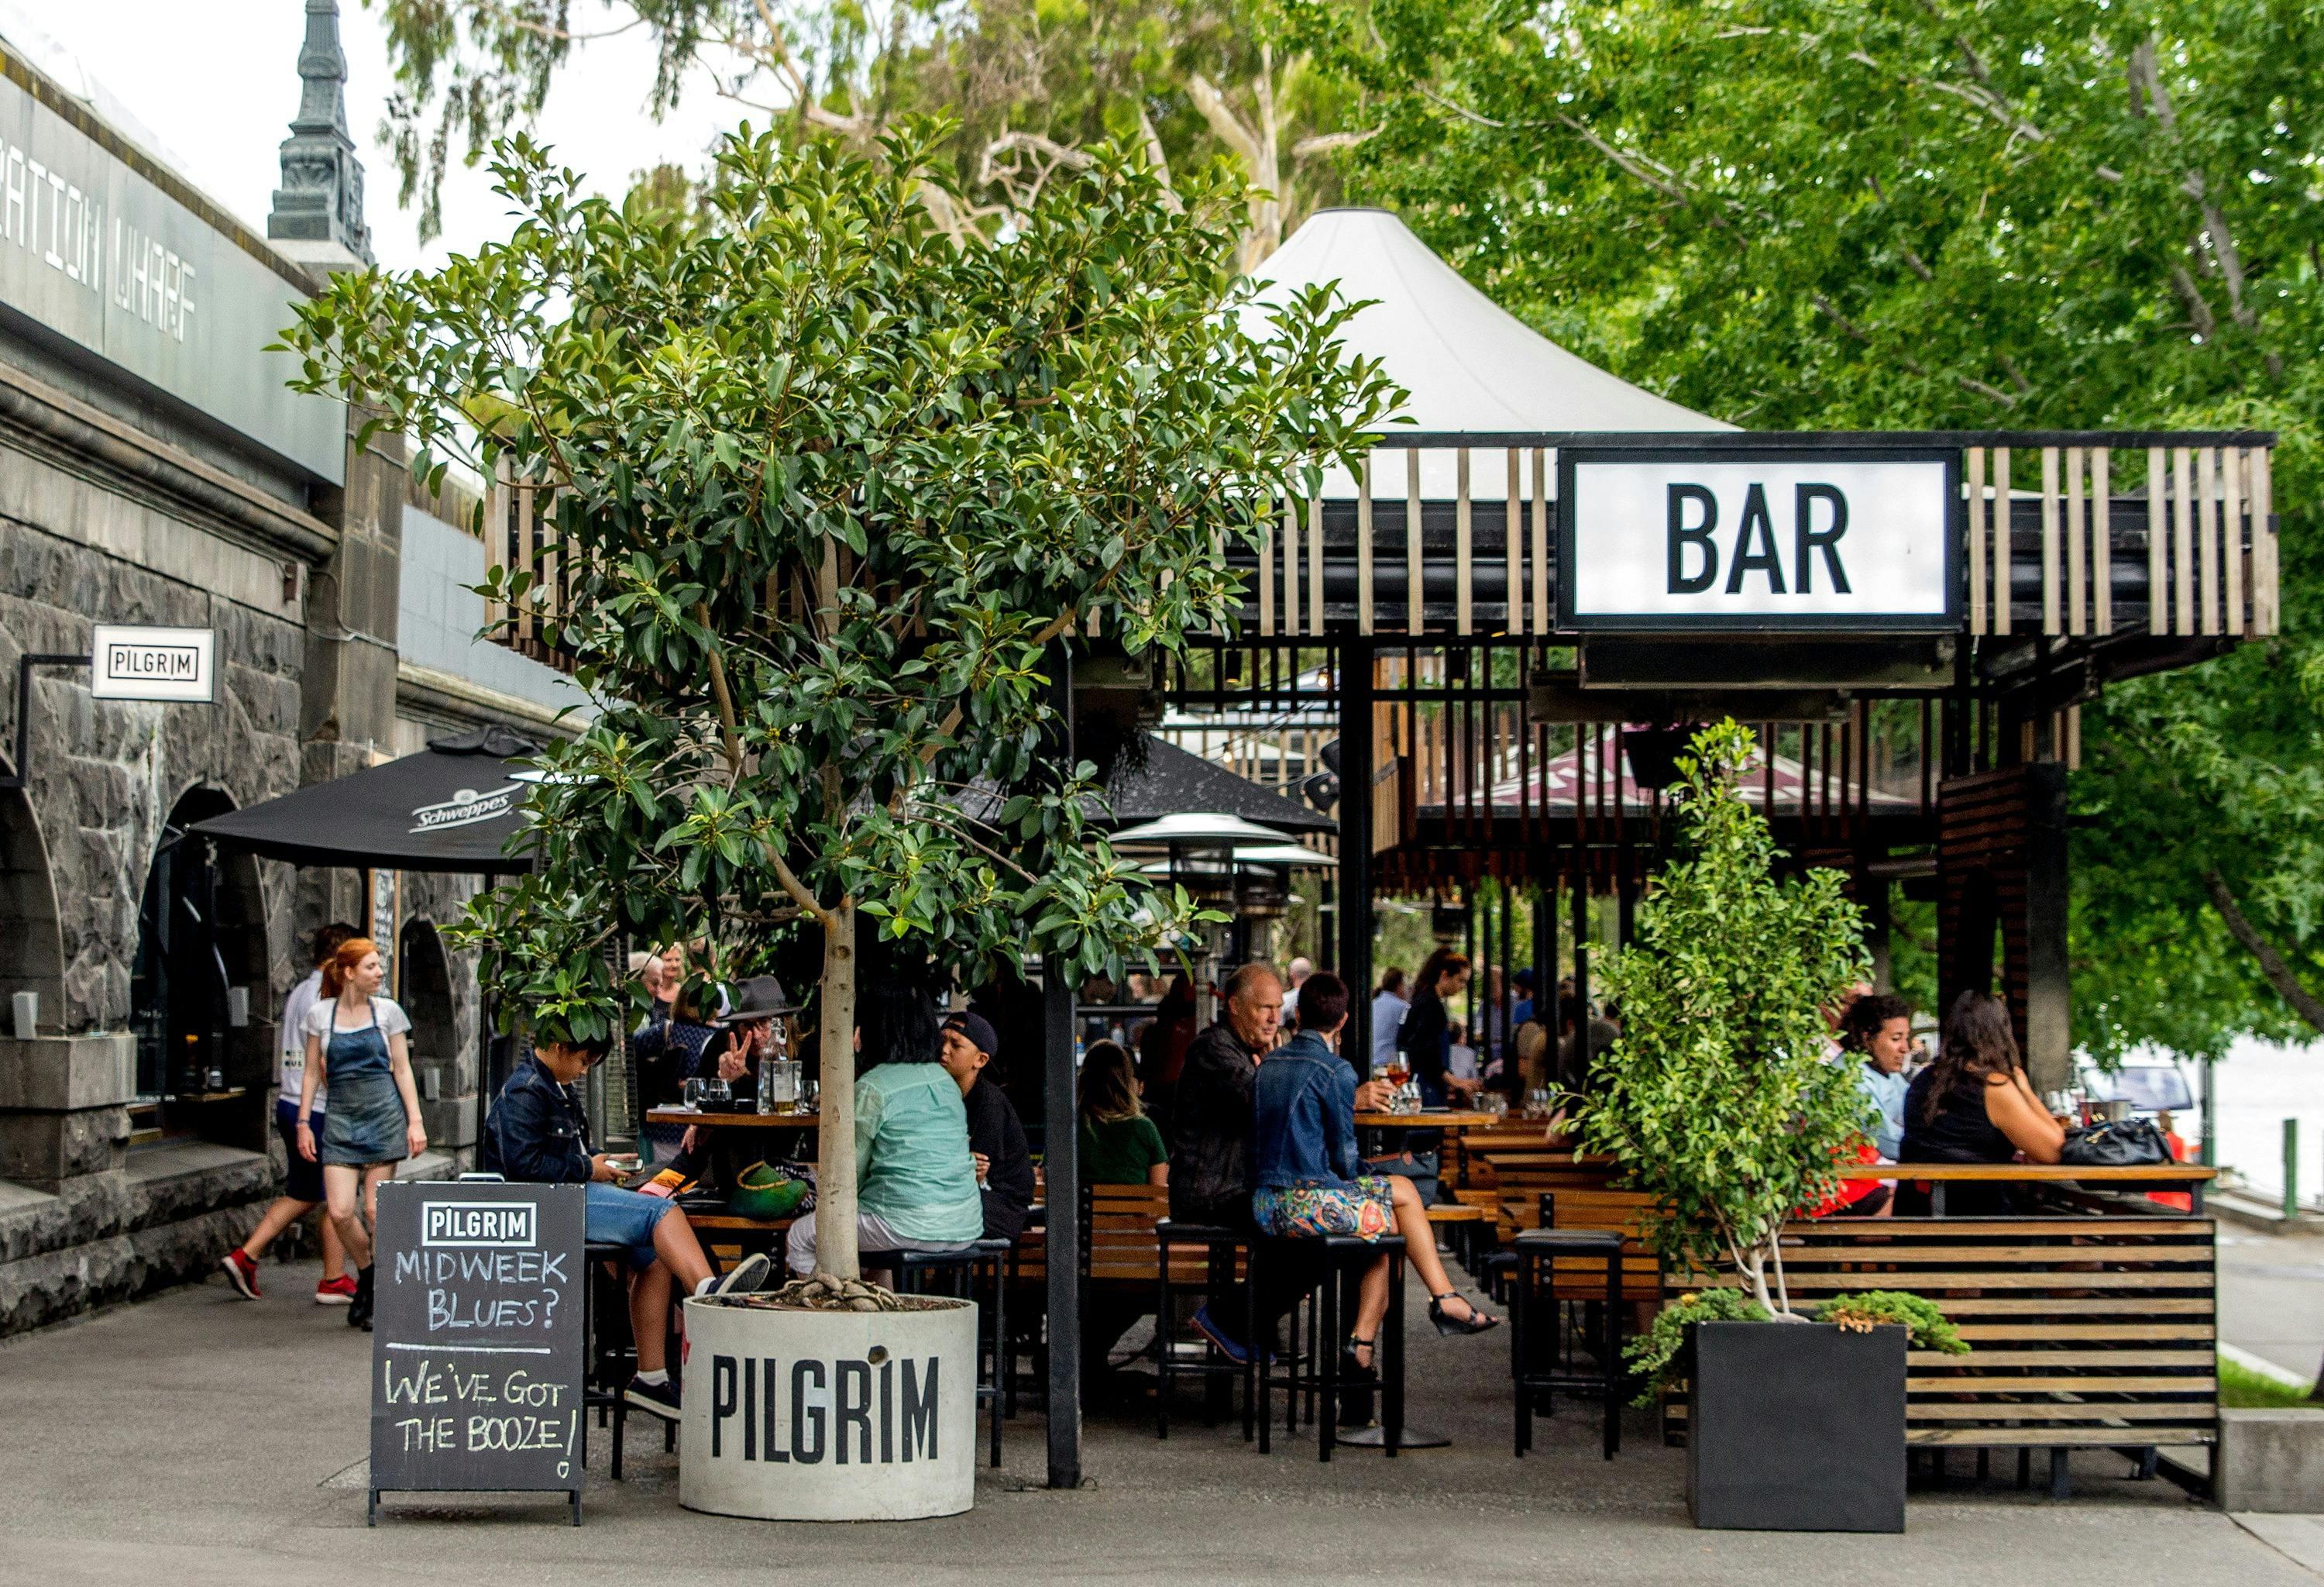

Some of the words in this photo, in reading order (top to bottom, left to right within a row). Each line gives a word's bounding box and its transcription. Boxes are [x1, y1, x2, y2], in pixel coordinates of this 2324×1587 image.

[0, 136, 101, 294] ATION
[114, 216, 195, 343] WHARF
[1666, 482, 1851, 594] BAR
[115, 650, 191, 675] PILGRIM
[417, 794, 509, 828] Schweppes
[431, 1207, 527, 1241] PILGRIM
[395, 1249, 569, 1285] MIDWEEK
[428, 1288, 560, 1331] BLUES?
[385, 1360, 497, 1404] WE'VE
[504, 1369, 569, 1407] GOT
[712, 1354, 939, 1464] PILGRIM
[395, 1417, 456, 1453] THE
[467, 1409, 577, 1479] BOOZE!
